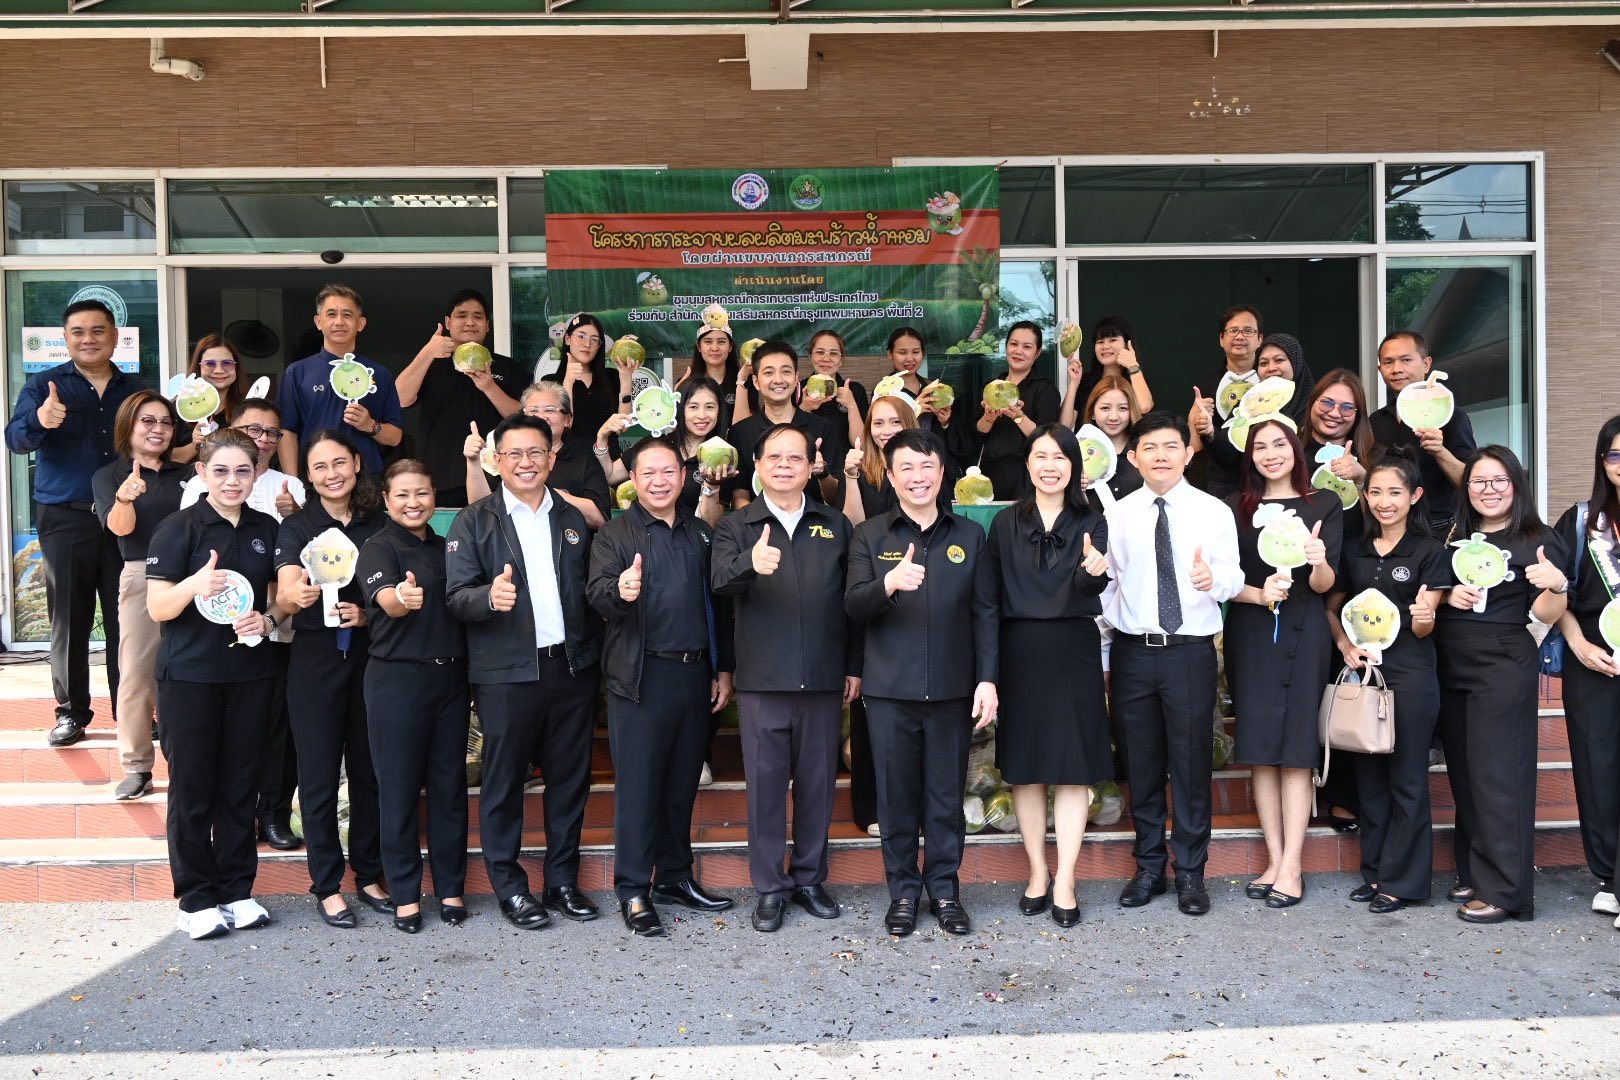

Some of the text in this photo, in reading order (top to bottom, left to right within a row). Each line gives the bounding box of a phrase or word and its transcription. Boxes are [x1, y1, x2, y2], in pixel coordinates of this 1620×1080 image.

[589, 212, 931, 248] โครงการกระจายผลผลิตมะพร้าวน้ำหอม
[682, 247, 872, 264] โดยผ่านขบวนการสหกรณ์
[734, 274, 824, 286] ดำเนินงานโดย
[673, 291, 878, 307] ชุมนุมสหกรณ์การเกษตรแห่งประเทศไทย
[628, 309, 667, 321] ร่วมกับ
[887, 302, 913, 318] พื้นที่
[914, 306, 924, 318] 2
[366, 571, 383, 584] CPD
